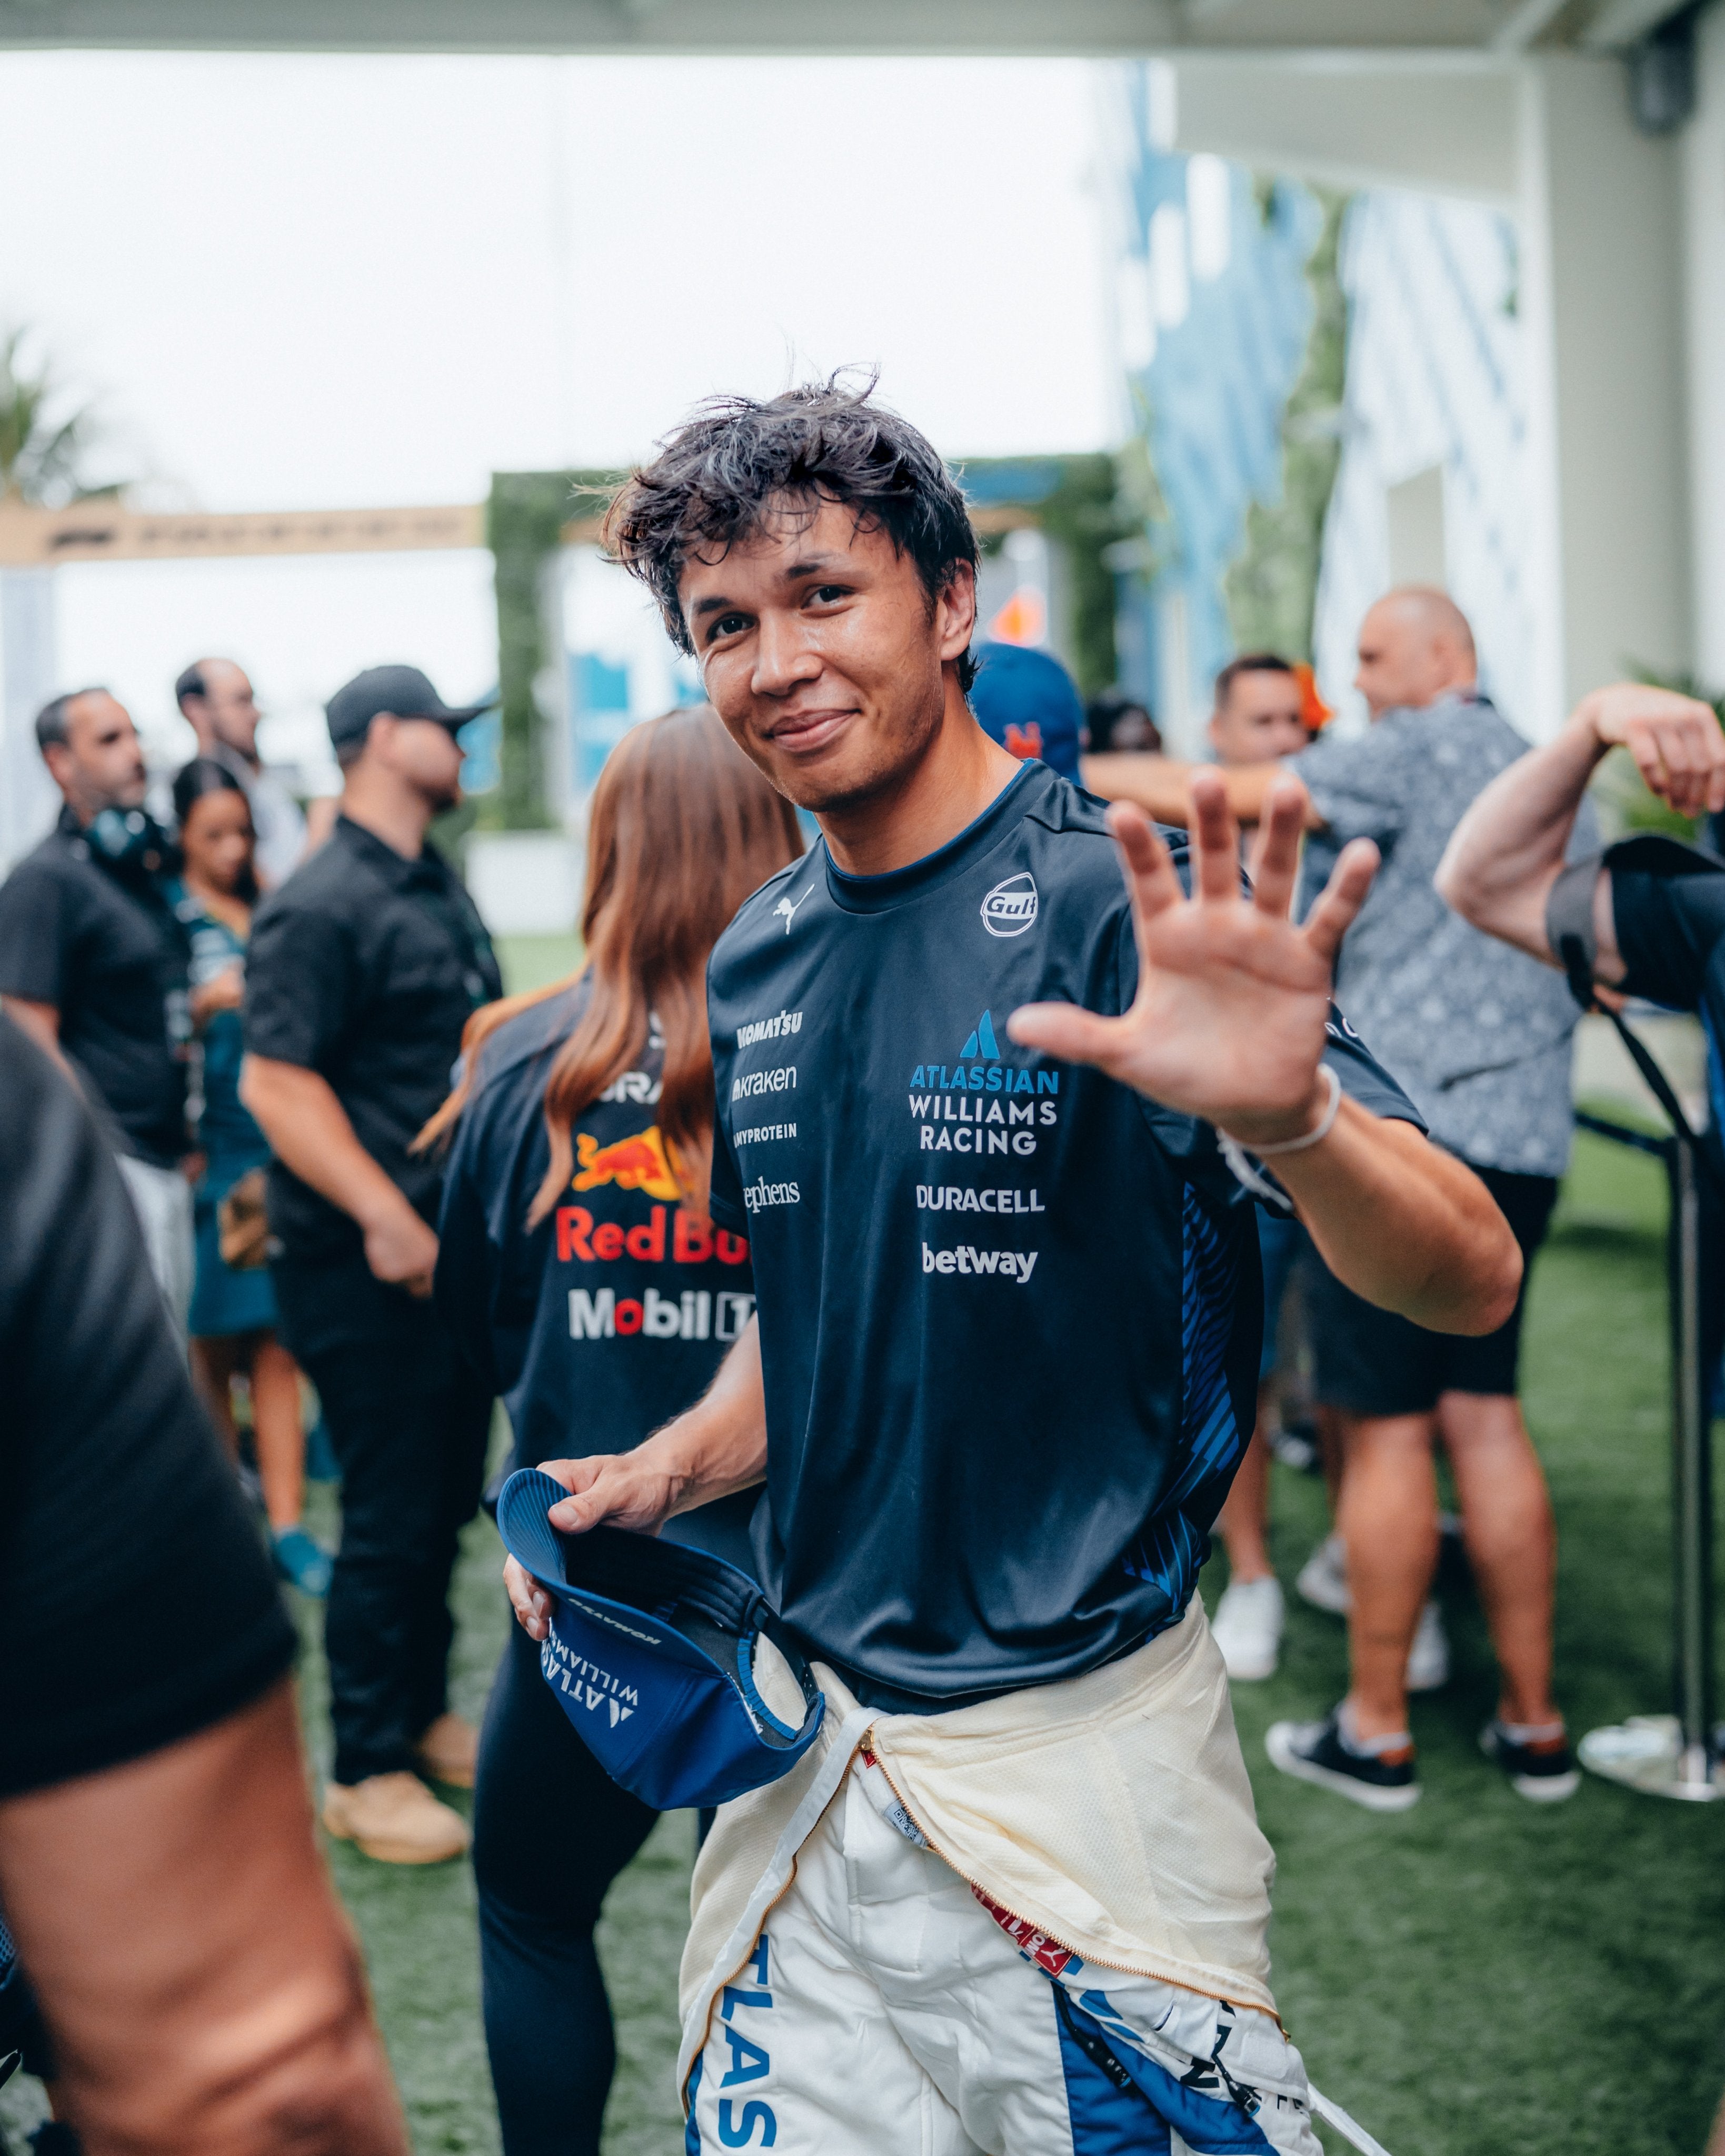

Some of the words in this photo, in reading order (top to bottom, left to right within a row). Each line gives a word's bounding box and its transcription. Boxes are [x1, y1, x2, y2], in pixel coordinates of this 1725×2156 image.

[986, 896, 1036, 914] Gulf
[740, 1066, 797, 1099] kraken
[910, 1065, 1059, 1094] ATLASSIAN
[909, 1094, 1057, 1125] WILLIAMS
[736, 1123, 797, 1147] MYPROTEIN
[920, 1125, 1037, 1155] RACING
[743, 1175, 800, 1214] ephens
[916, 1185, 1045, 1213] DURACELL
[556, 1204, 666, 1262] Red
[672, 1207, 753, 1265] Bu
[922, 1242, 1039, 1284] betway
[567, 1287, 711, 1340] Mobil
[541, 1638, 606, 1711] ATLAS
